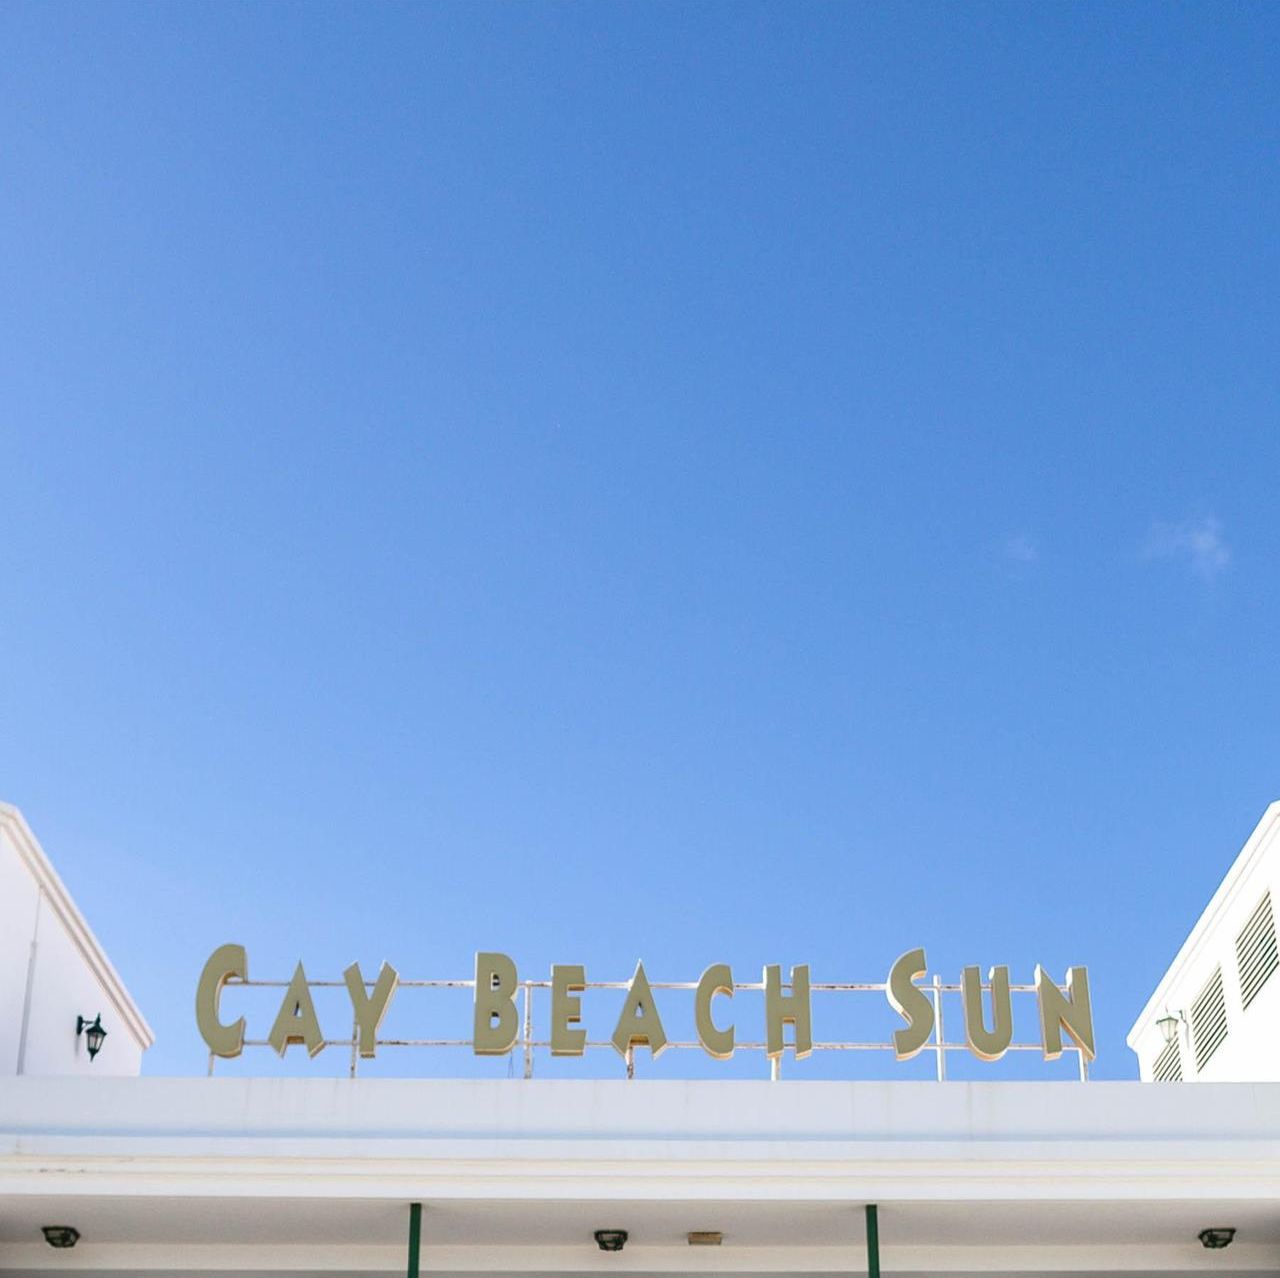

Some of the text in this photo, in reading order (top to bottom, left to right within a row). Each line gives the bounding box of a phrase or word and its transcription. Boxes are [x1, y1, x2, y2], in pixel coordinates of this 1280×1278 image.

[195, 943, 1096, 1061] CAY BEACH SUN
